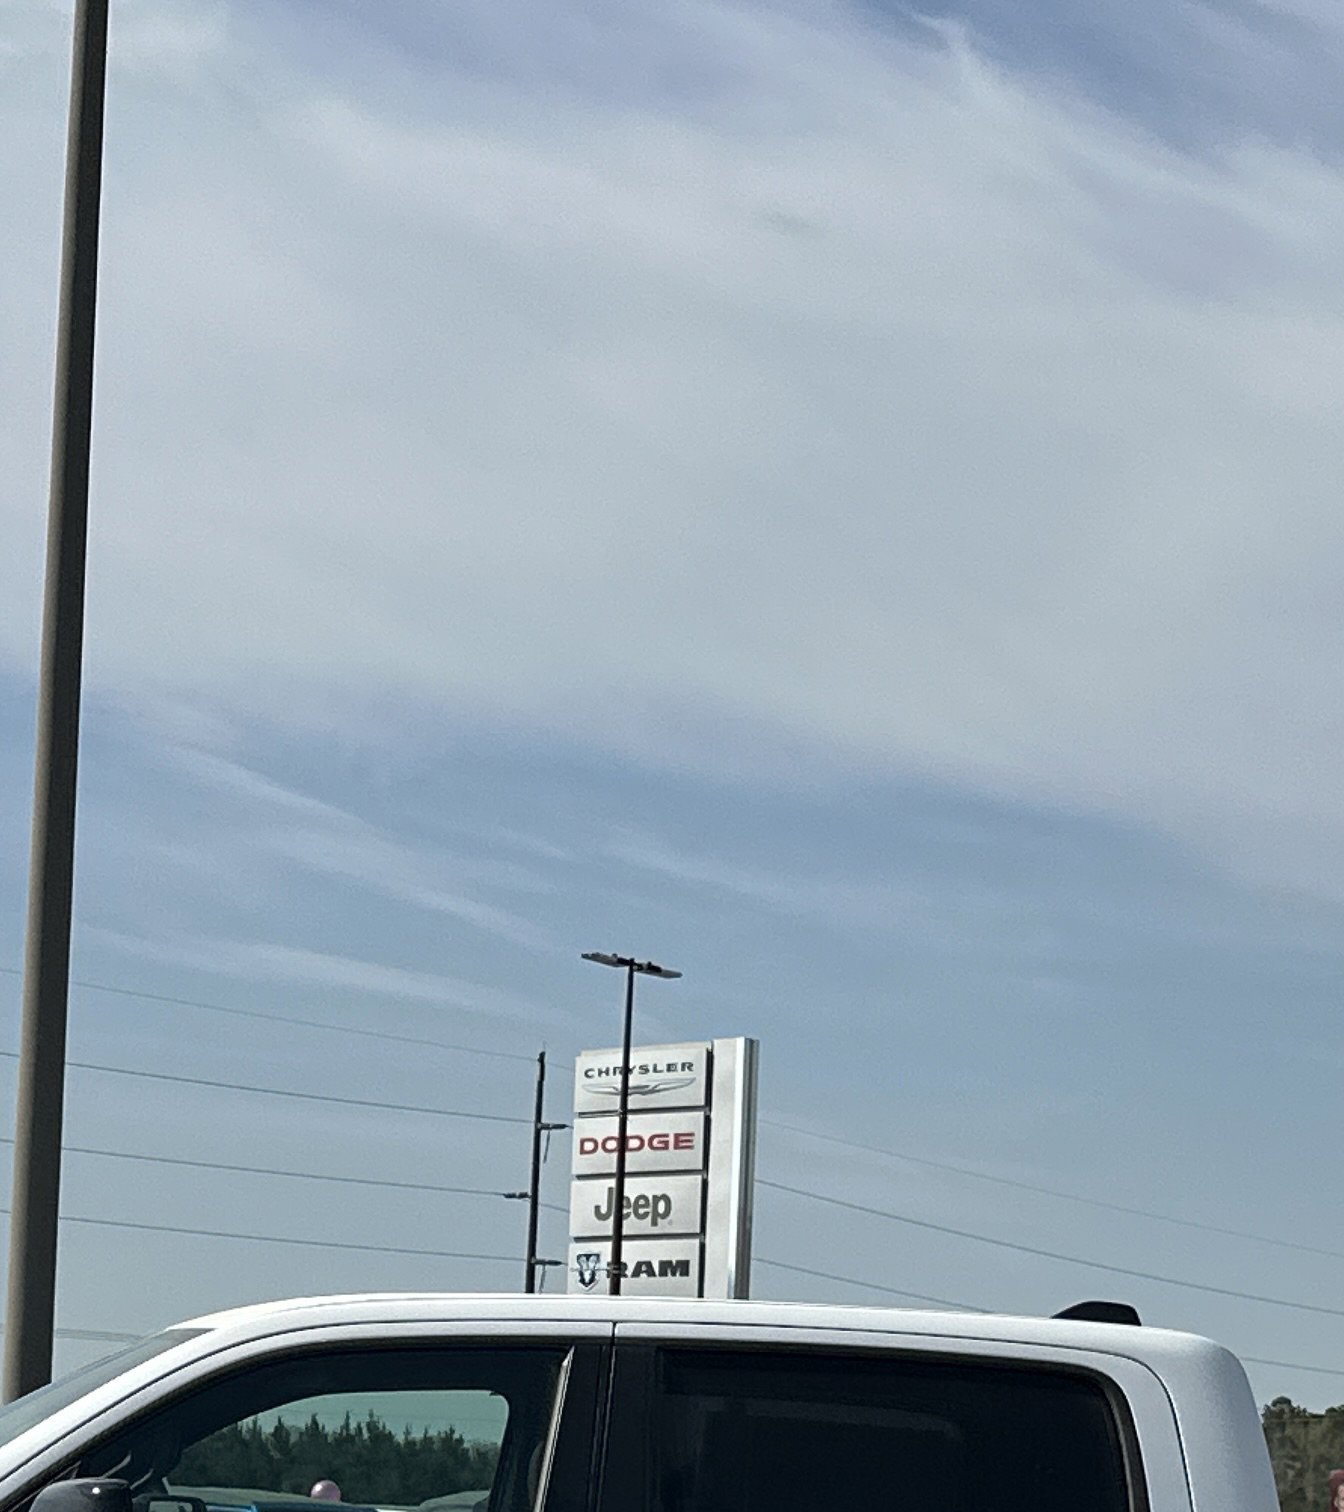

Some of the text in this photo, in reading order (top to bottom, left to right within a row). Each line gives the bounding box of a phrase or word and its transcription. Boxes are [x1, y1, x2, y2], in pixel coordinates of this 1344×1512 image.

[584, 1062, 694, 1079] CHRYSLER
[579, 1132, 695, 1155] DODGE
[594, 1186, 672, 1227] Jeep
